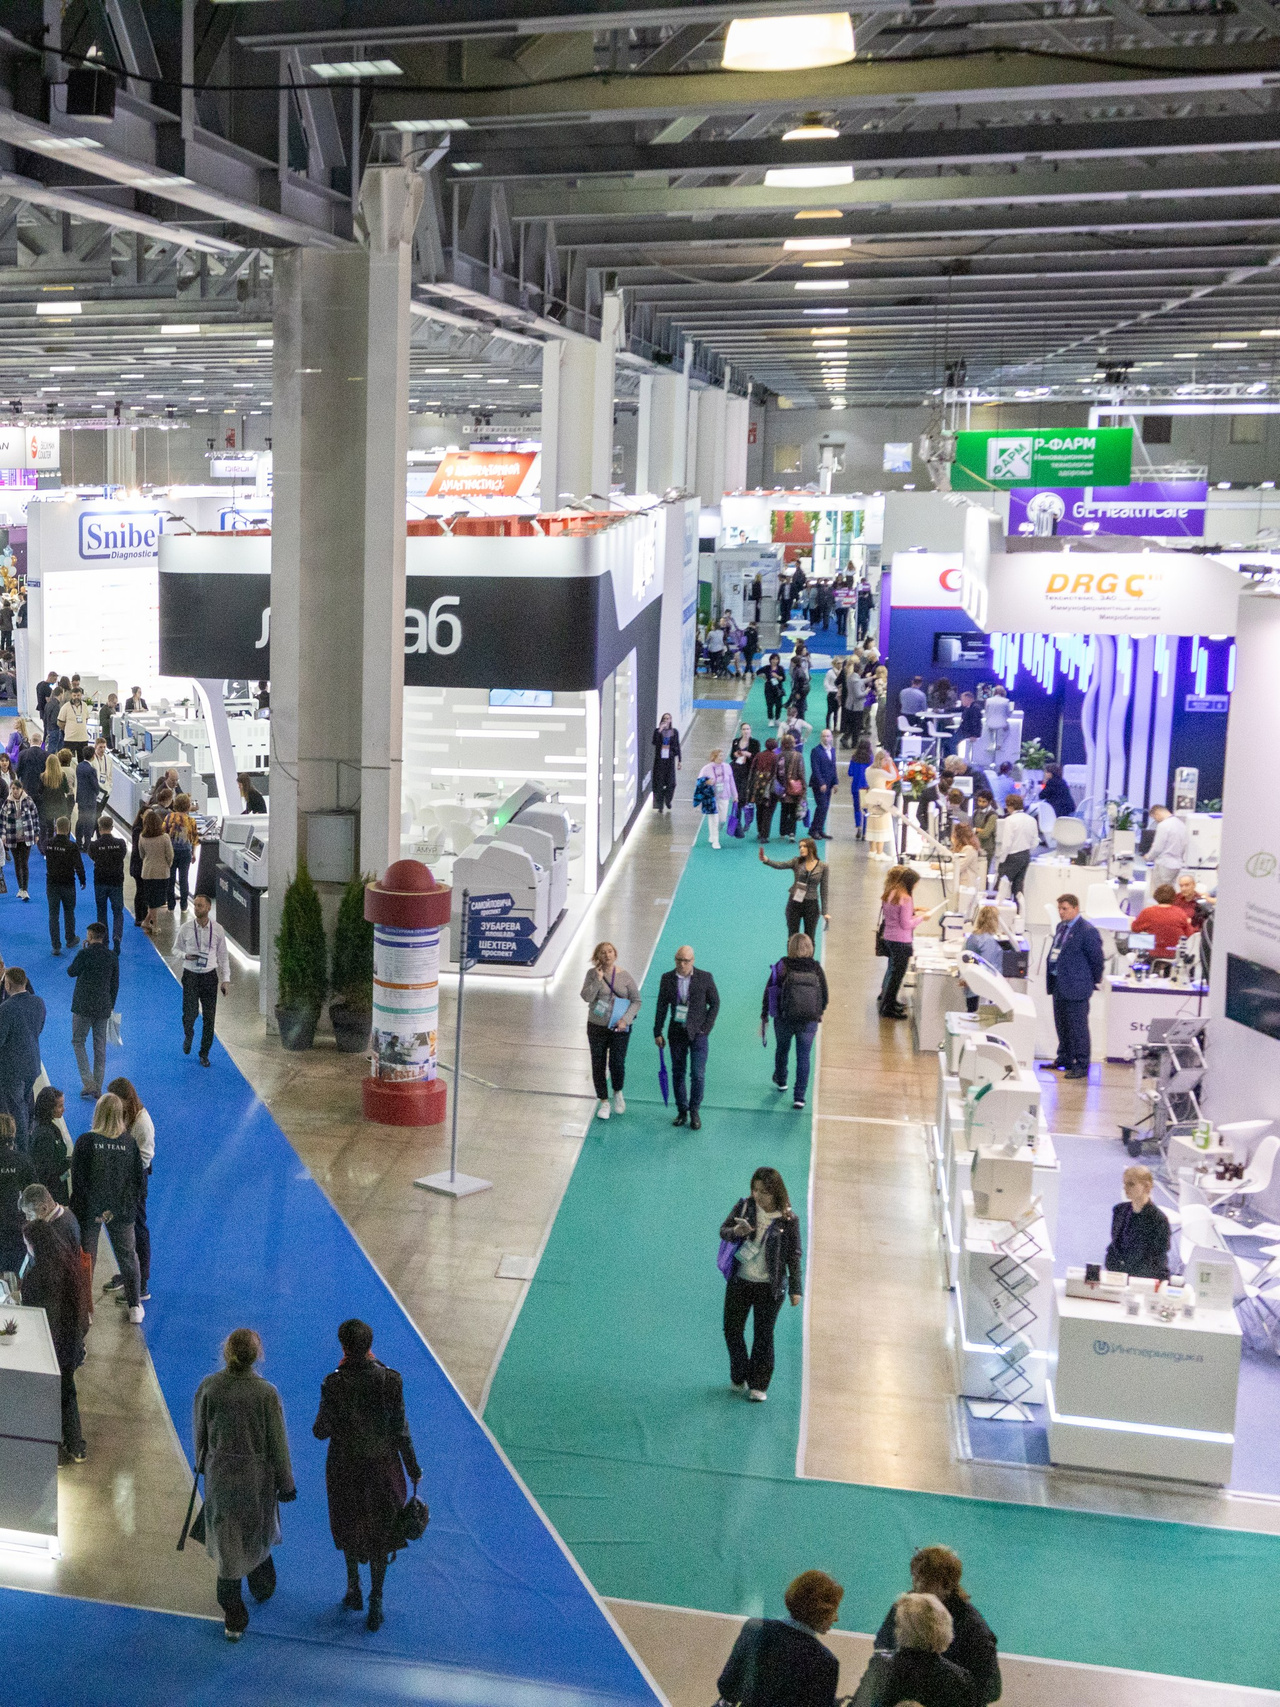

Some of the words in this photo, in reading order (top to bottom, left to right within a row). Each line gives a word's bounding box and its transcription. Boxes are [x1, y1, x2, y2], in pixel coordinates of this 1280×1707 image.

[1034, 436, 1097, 451] Р-ФАРМ
[86, 521, 156, 551] Snibe
[110, 550, 152, 561] Diagnostic
[470, 898, 512, 911] САМОЙЛОВИЧА
[480, 922, 521, 931] ЗУБАРЕВА
[478, 940, 518, 950] ШЕХТЕРА
[106, 1143, 126, 1151] TEAM
